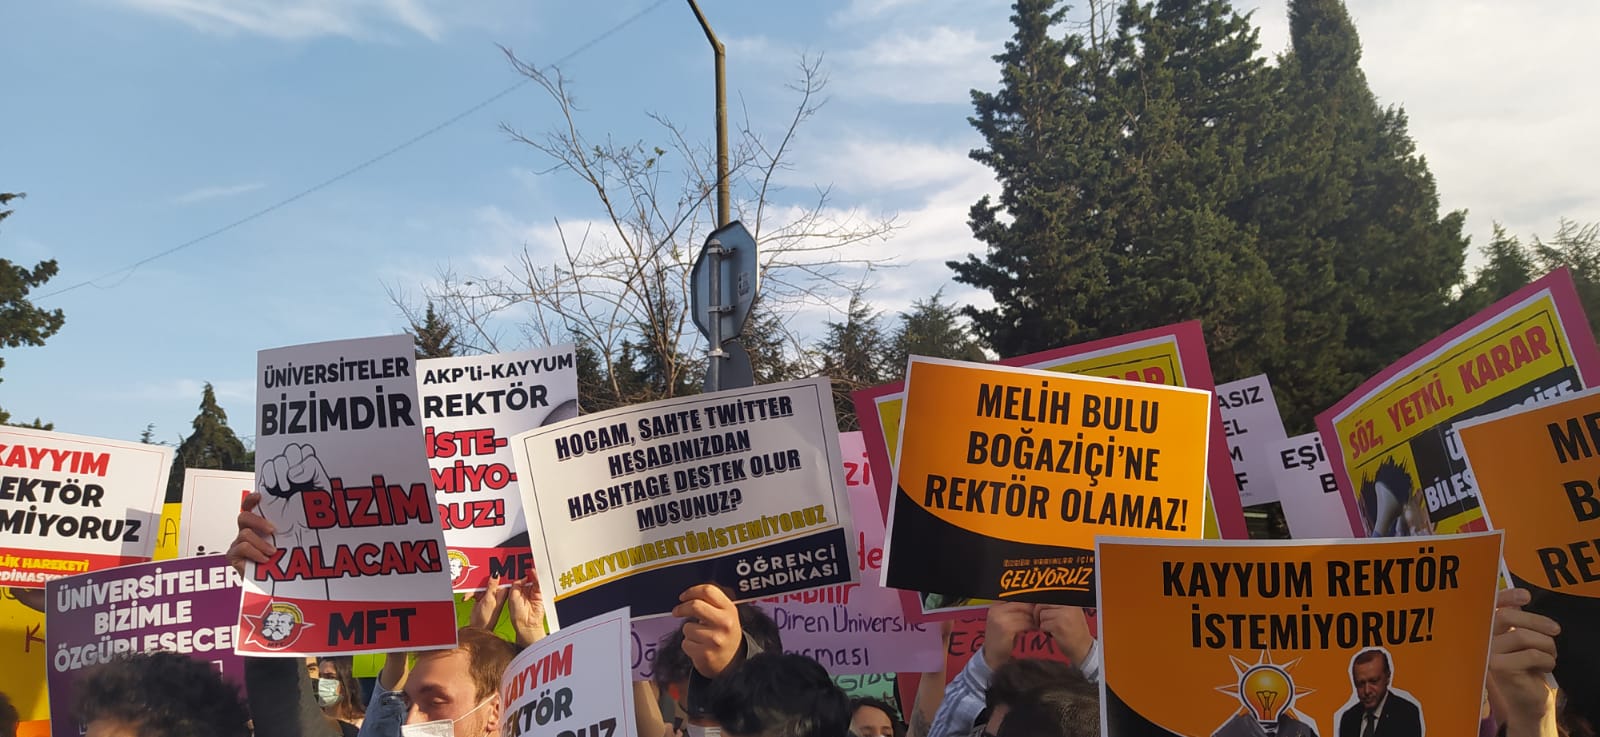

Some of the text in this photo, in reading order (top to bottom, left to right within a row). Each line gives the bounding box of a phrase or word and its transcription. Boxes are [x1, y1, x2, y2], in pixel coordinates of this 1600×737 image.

[264, 356, 411, 389] ÜNİVERSİTELER
[423, 353, 573, 385] AKP'li-KAYYUM
[261, 385, 415, 436] BİZİMDİR
[423, 381, 549, 419] REKTÖR
[976, 381, 1159, 434] MELİH BULU
[1349, 418, 1384, 460] SÖZ,
[1387, 373, 1454, 433] YETKİ,
[1457, 326, 1552, 394] KARAR
[555, 395, 793, 461] HOCAM, SAHTE TWİTTER
[608, 429, 752, 478] HESABINIZDAN
[966, 426, 1161, 487] BOĞAZİÇİ'NE
[302, 475, 433, 530] BİZİM
[567, 449, 801, 521] HASHTAGE DESTEK OLUR
[924, 473, 1188, 532] REKTÖR OLAMAZ!
[636, 488, 743, 532] MUSUNUZ?
[22, 556, 90, 572] HAREKETİ
[254, 539, 442, 581] KALACAK!
[558, 504, 828, 590] #KAYYUMREKTÖRİSTEMİYORUZ
[736, 543, 836, 577] ÖĞRENCİ
[738, 562, 839, 593] SENDİKASI
[1162, 546, 1460, 598] KAYYUM REKTÖR
[94, 600, 192, 635] BİZİMLE
[328, 608, 416, 647] MFT
[774, 606, 829, 633] Diren
[1191, 604, 1435, 651] İSTEMİYORUZ!
